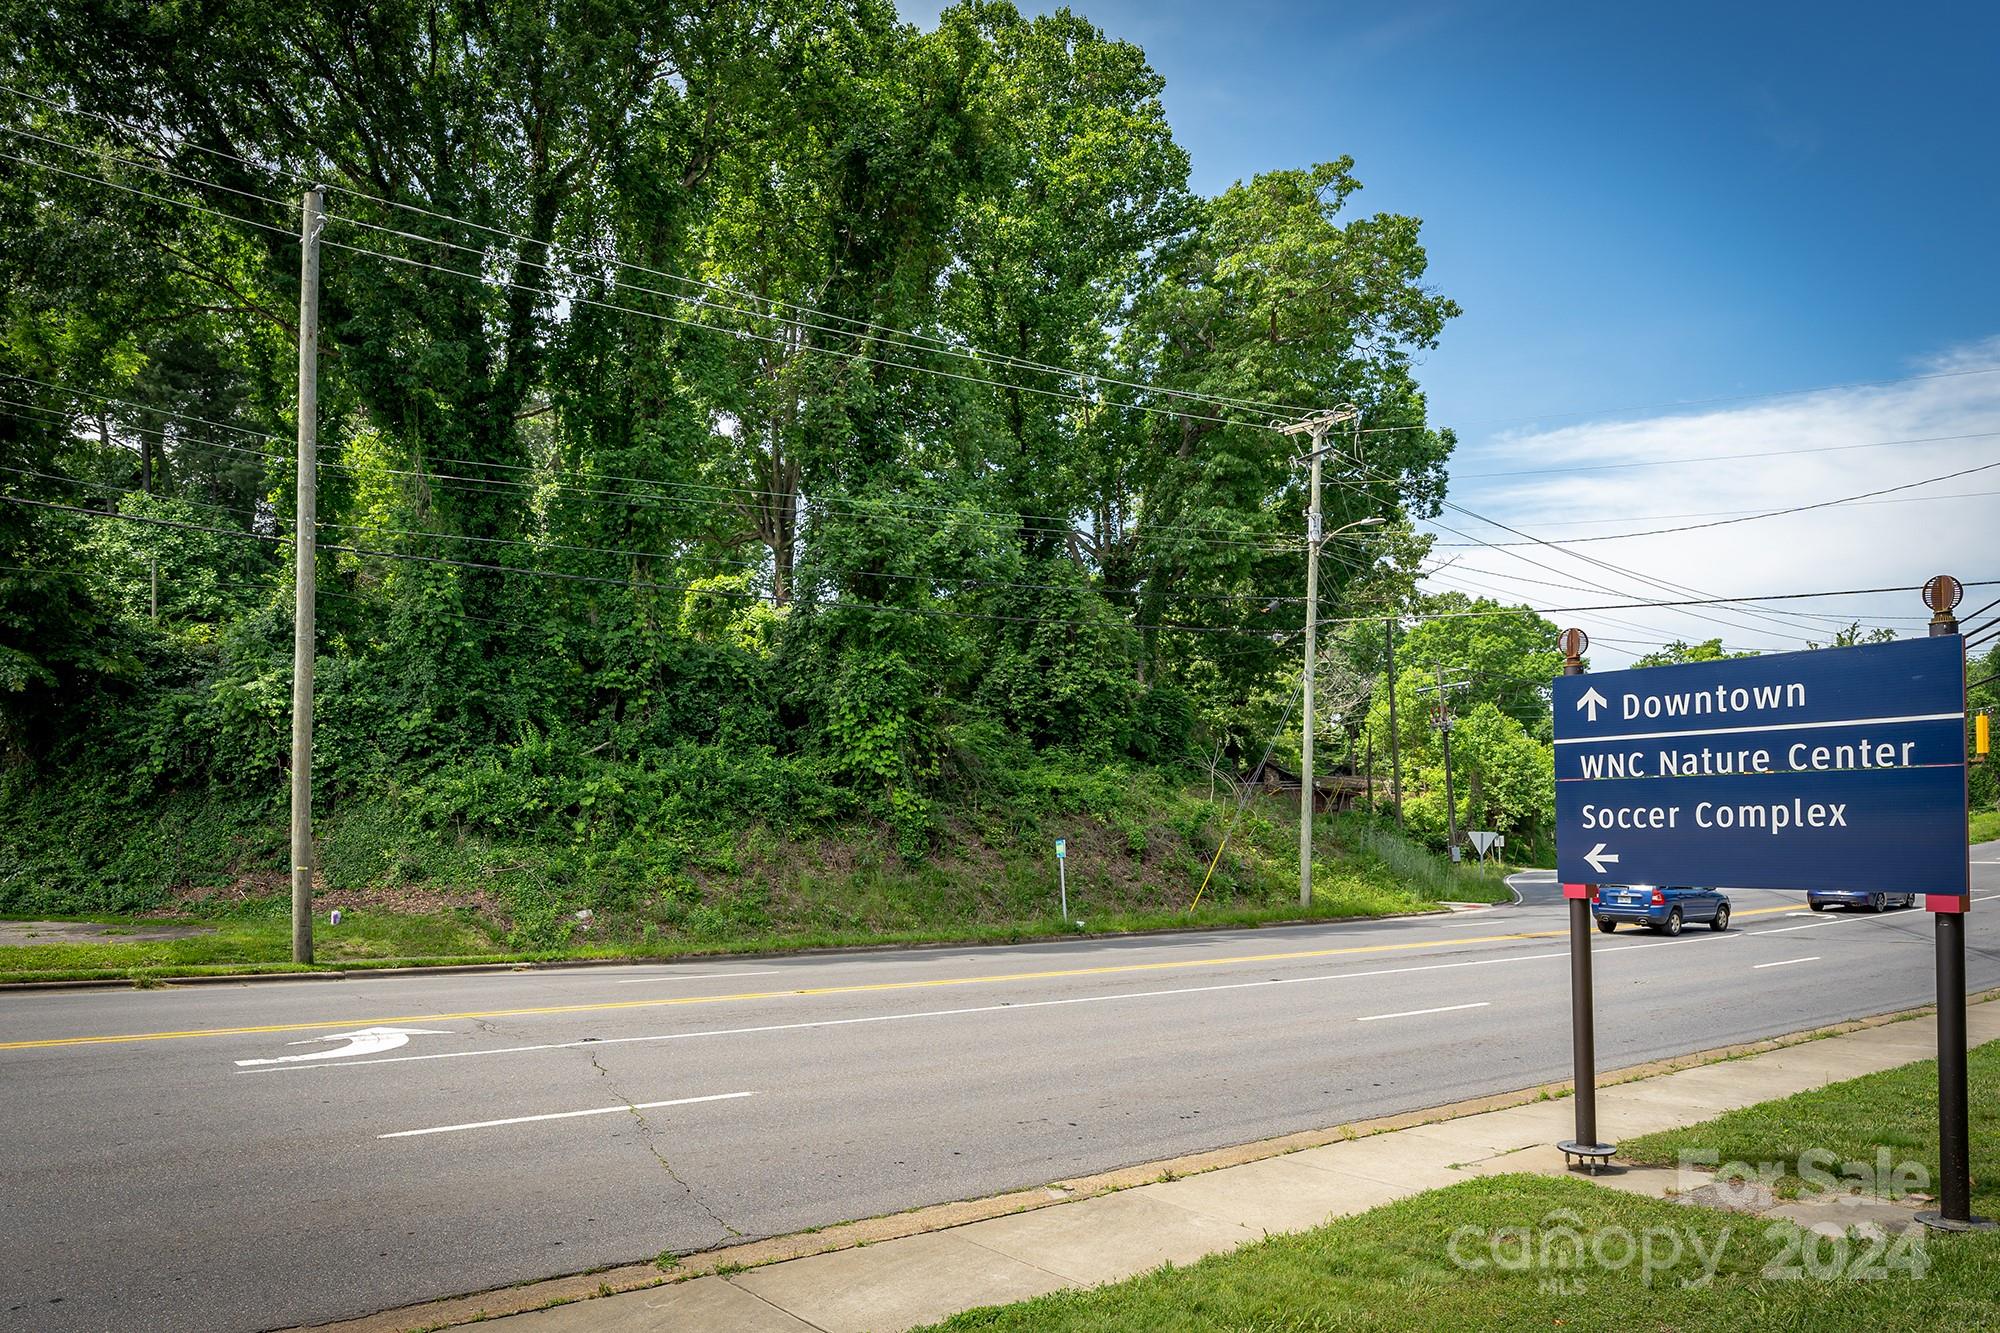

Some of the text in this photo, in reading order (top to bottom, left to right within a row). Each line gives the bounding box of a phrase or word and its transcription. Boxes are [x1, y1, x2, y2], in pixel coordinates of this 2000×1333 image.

[1622, 682, 1806, 720] Downtown
[1580, 739, 1916, 779] WNC Nature Center
[1582, 798, 1847, 835] Soccer Complex
